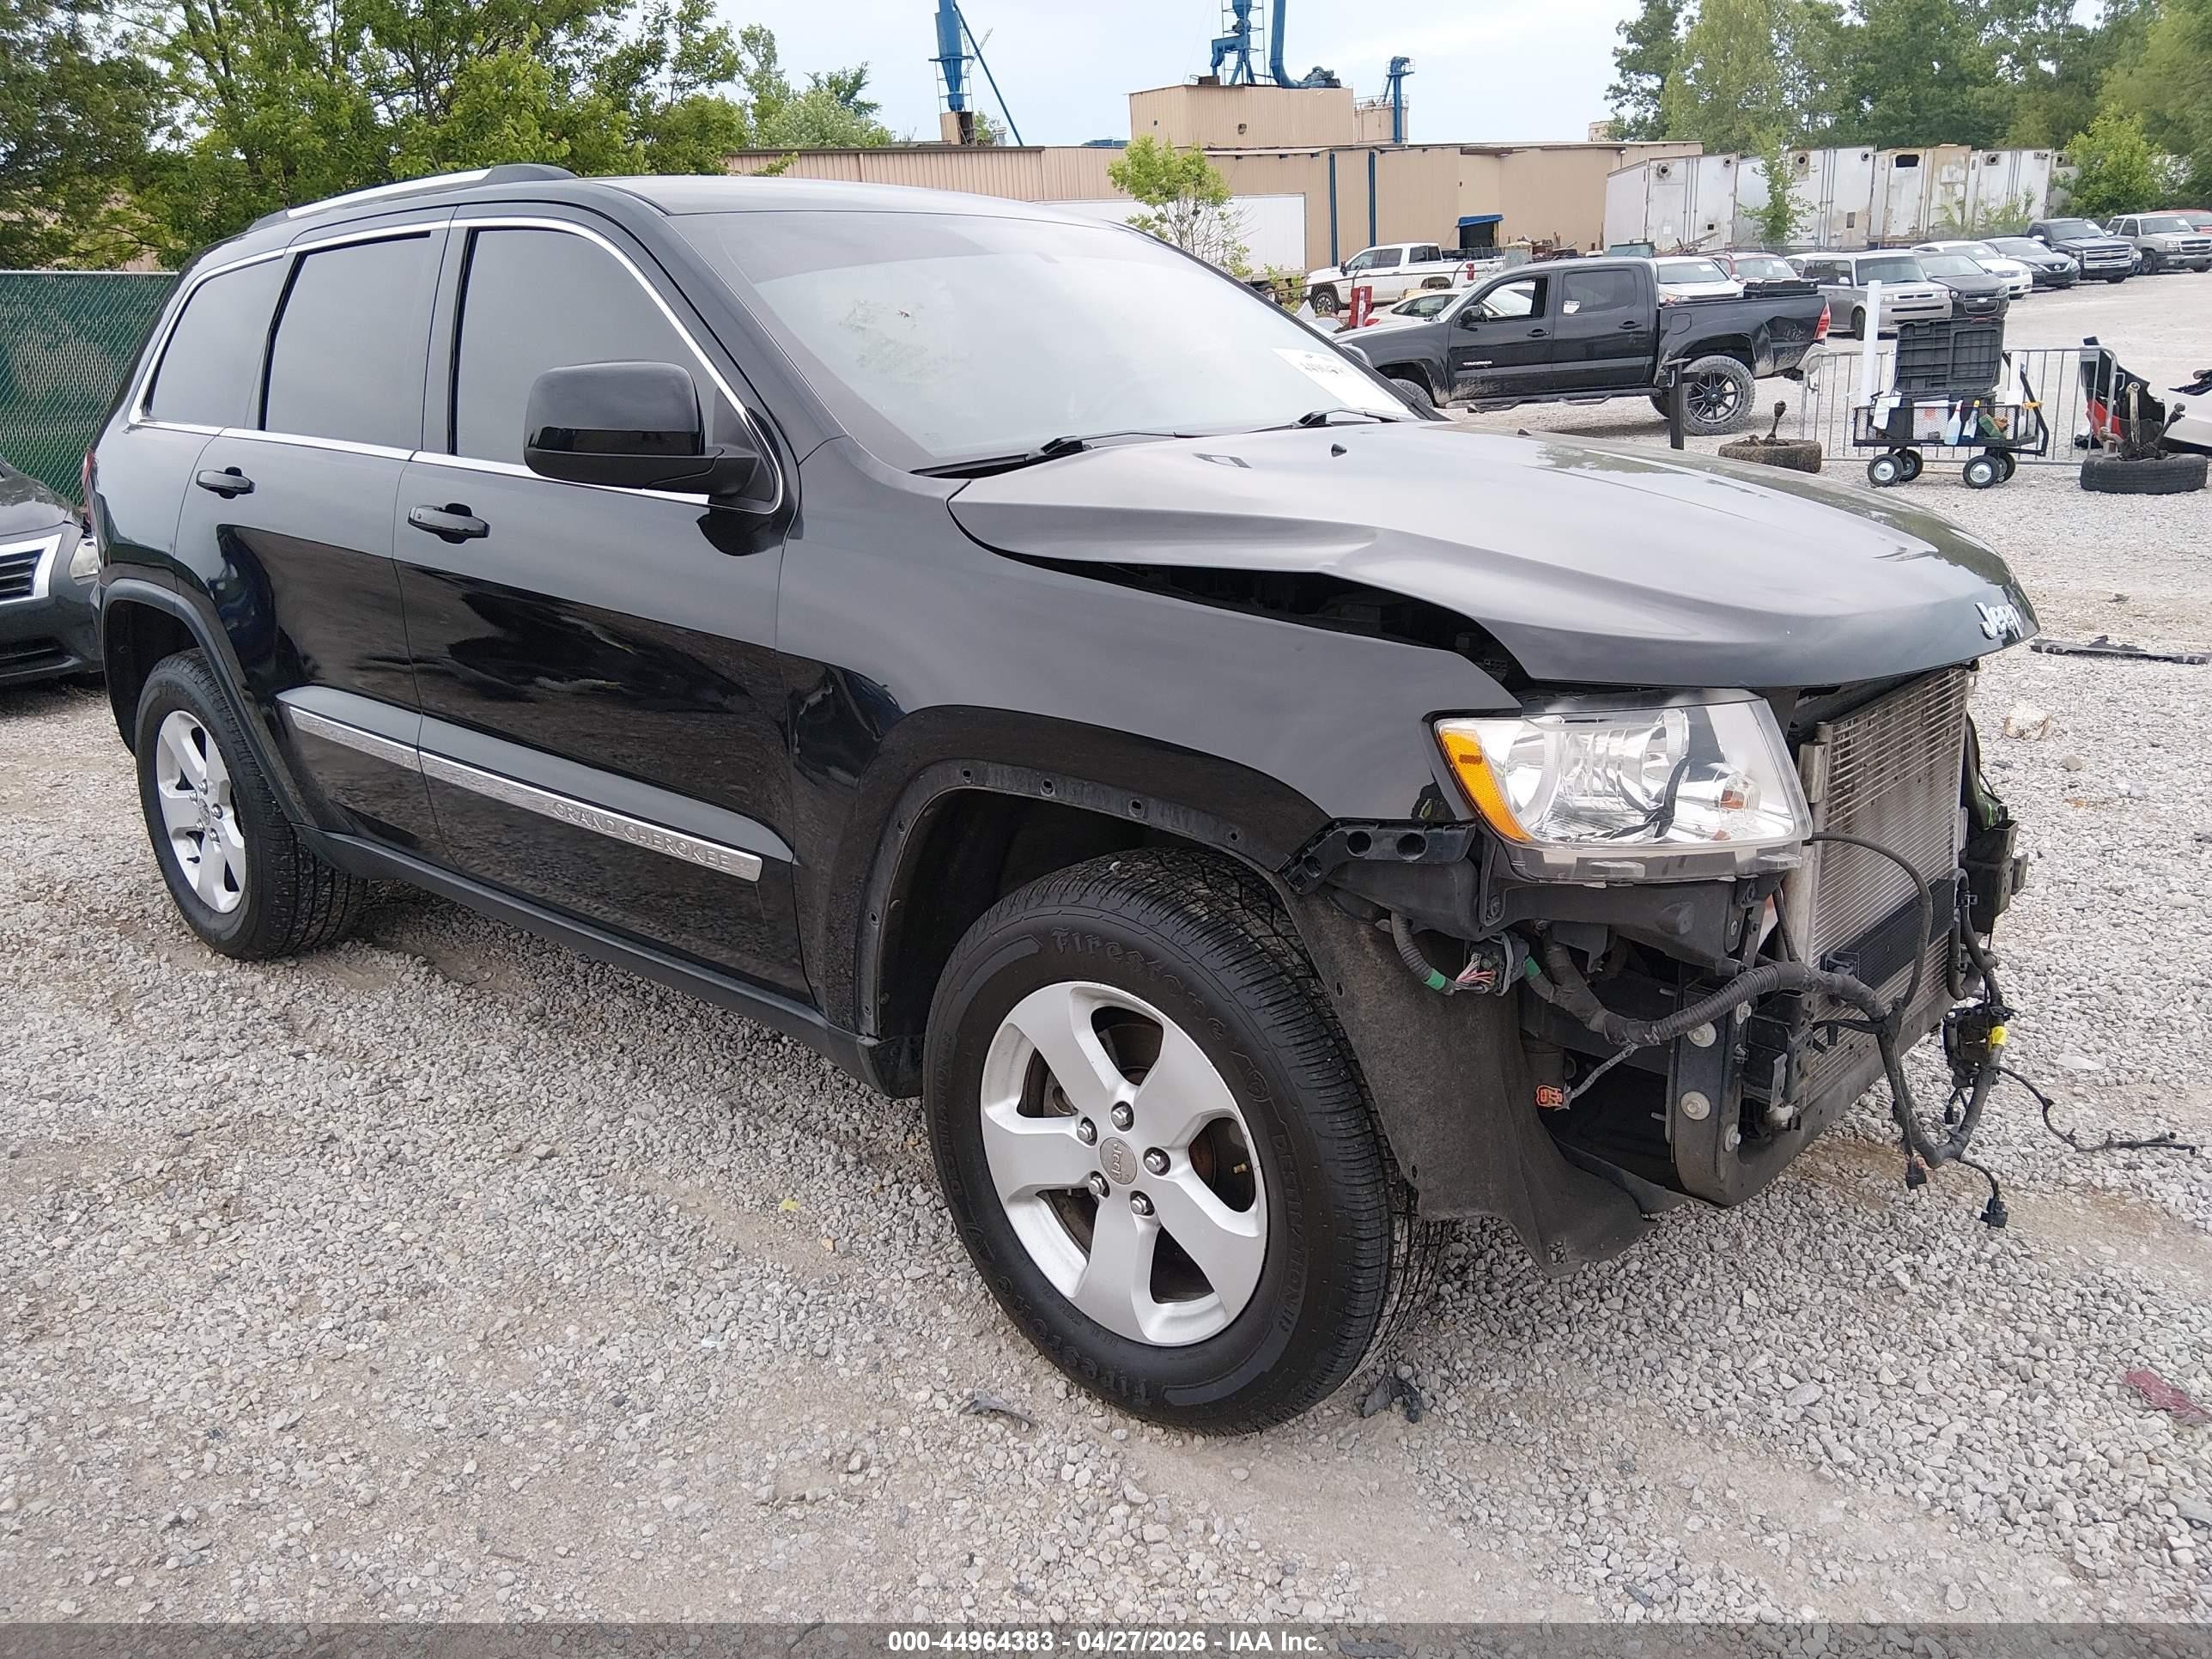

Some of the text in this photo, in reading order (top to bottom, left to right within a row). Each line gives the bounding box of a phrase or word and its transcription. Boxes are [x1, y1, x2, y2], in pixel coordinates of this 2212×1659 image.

[1975, 601, 2023, 640] Jeep
[554, 802, 730, 871] GRAND CHEROKEE
[1050, 927, 1224, 1042] Firestone
[1111, 1143, 1122, 1181] Jeep
